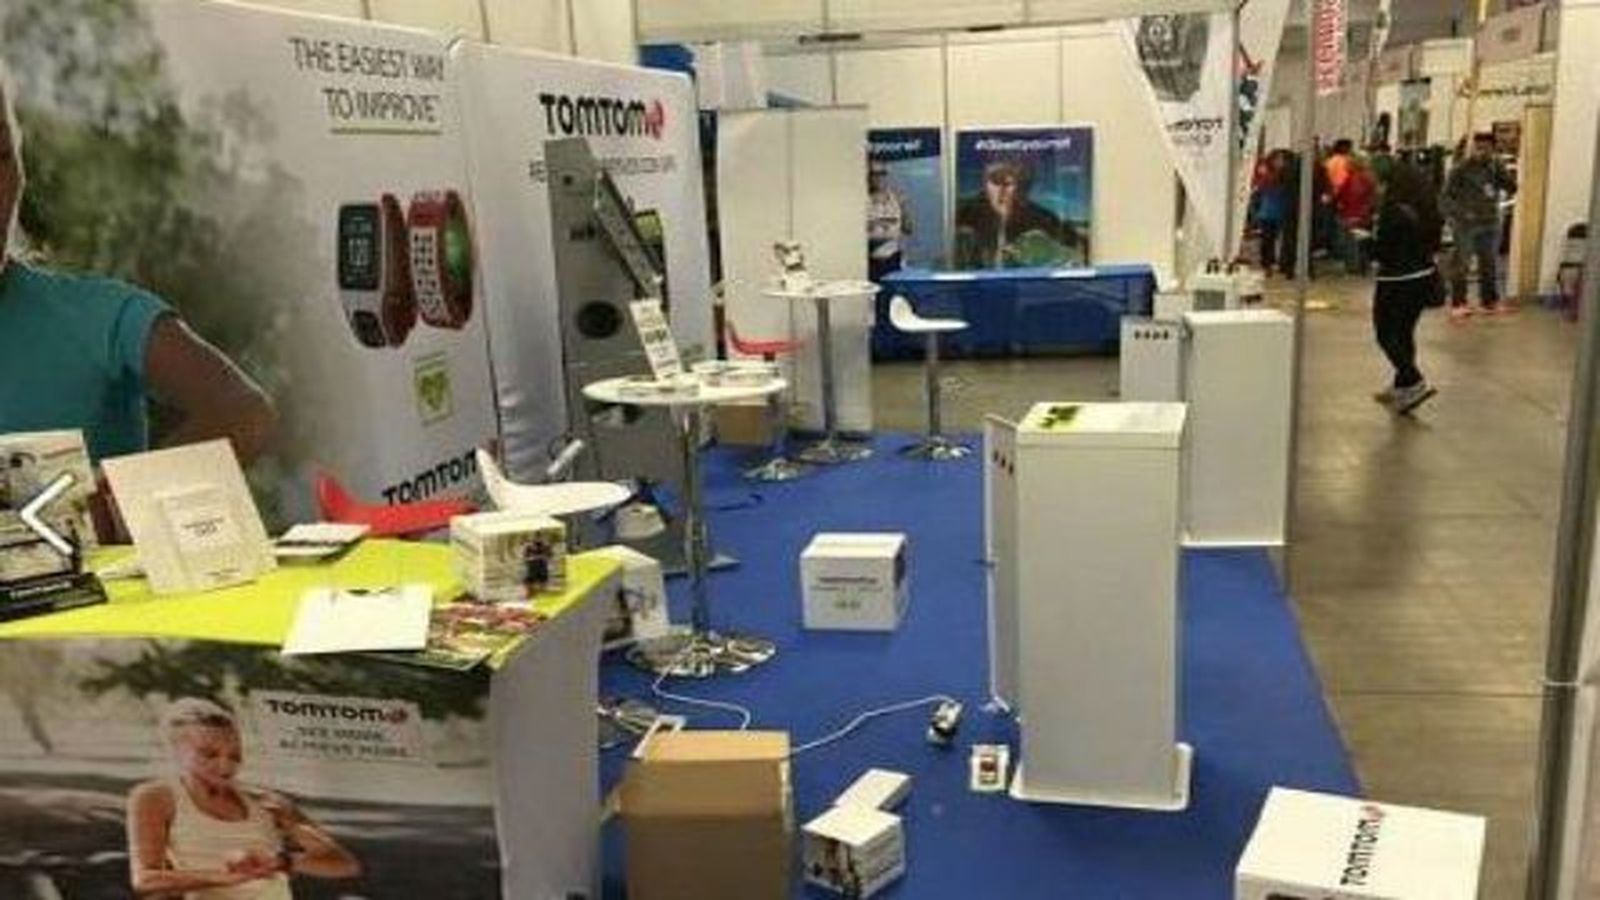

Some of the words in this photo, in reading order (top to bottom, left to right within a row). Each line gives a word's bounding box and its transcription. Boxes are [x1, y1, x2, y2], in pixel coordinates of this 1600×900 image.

[288, 37, 336, 72] THE
[338, 43, 408, 78] EASIEST
[321, 88, 353, 120] TO
[355, 90, 441, 124] IMPROVE
[539, 92, 650, 136] TOMTOM
[266, 698, 386, 722] TOMTOM
